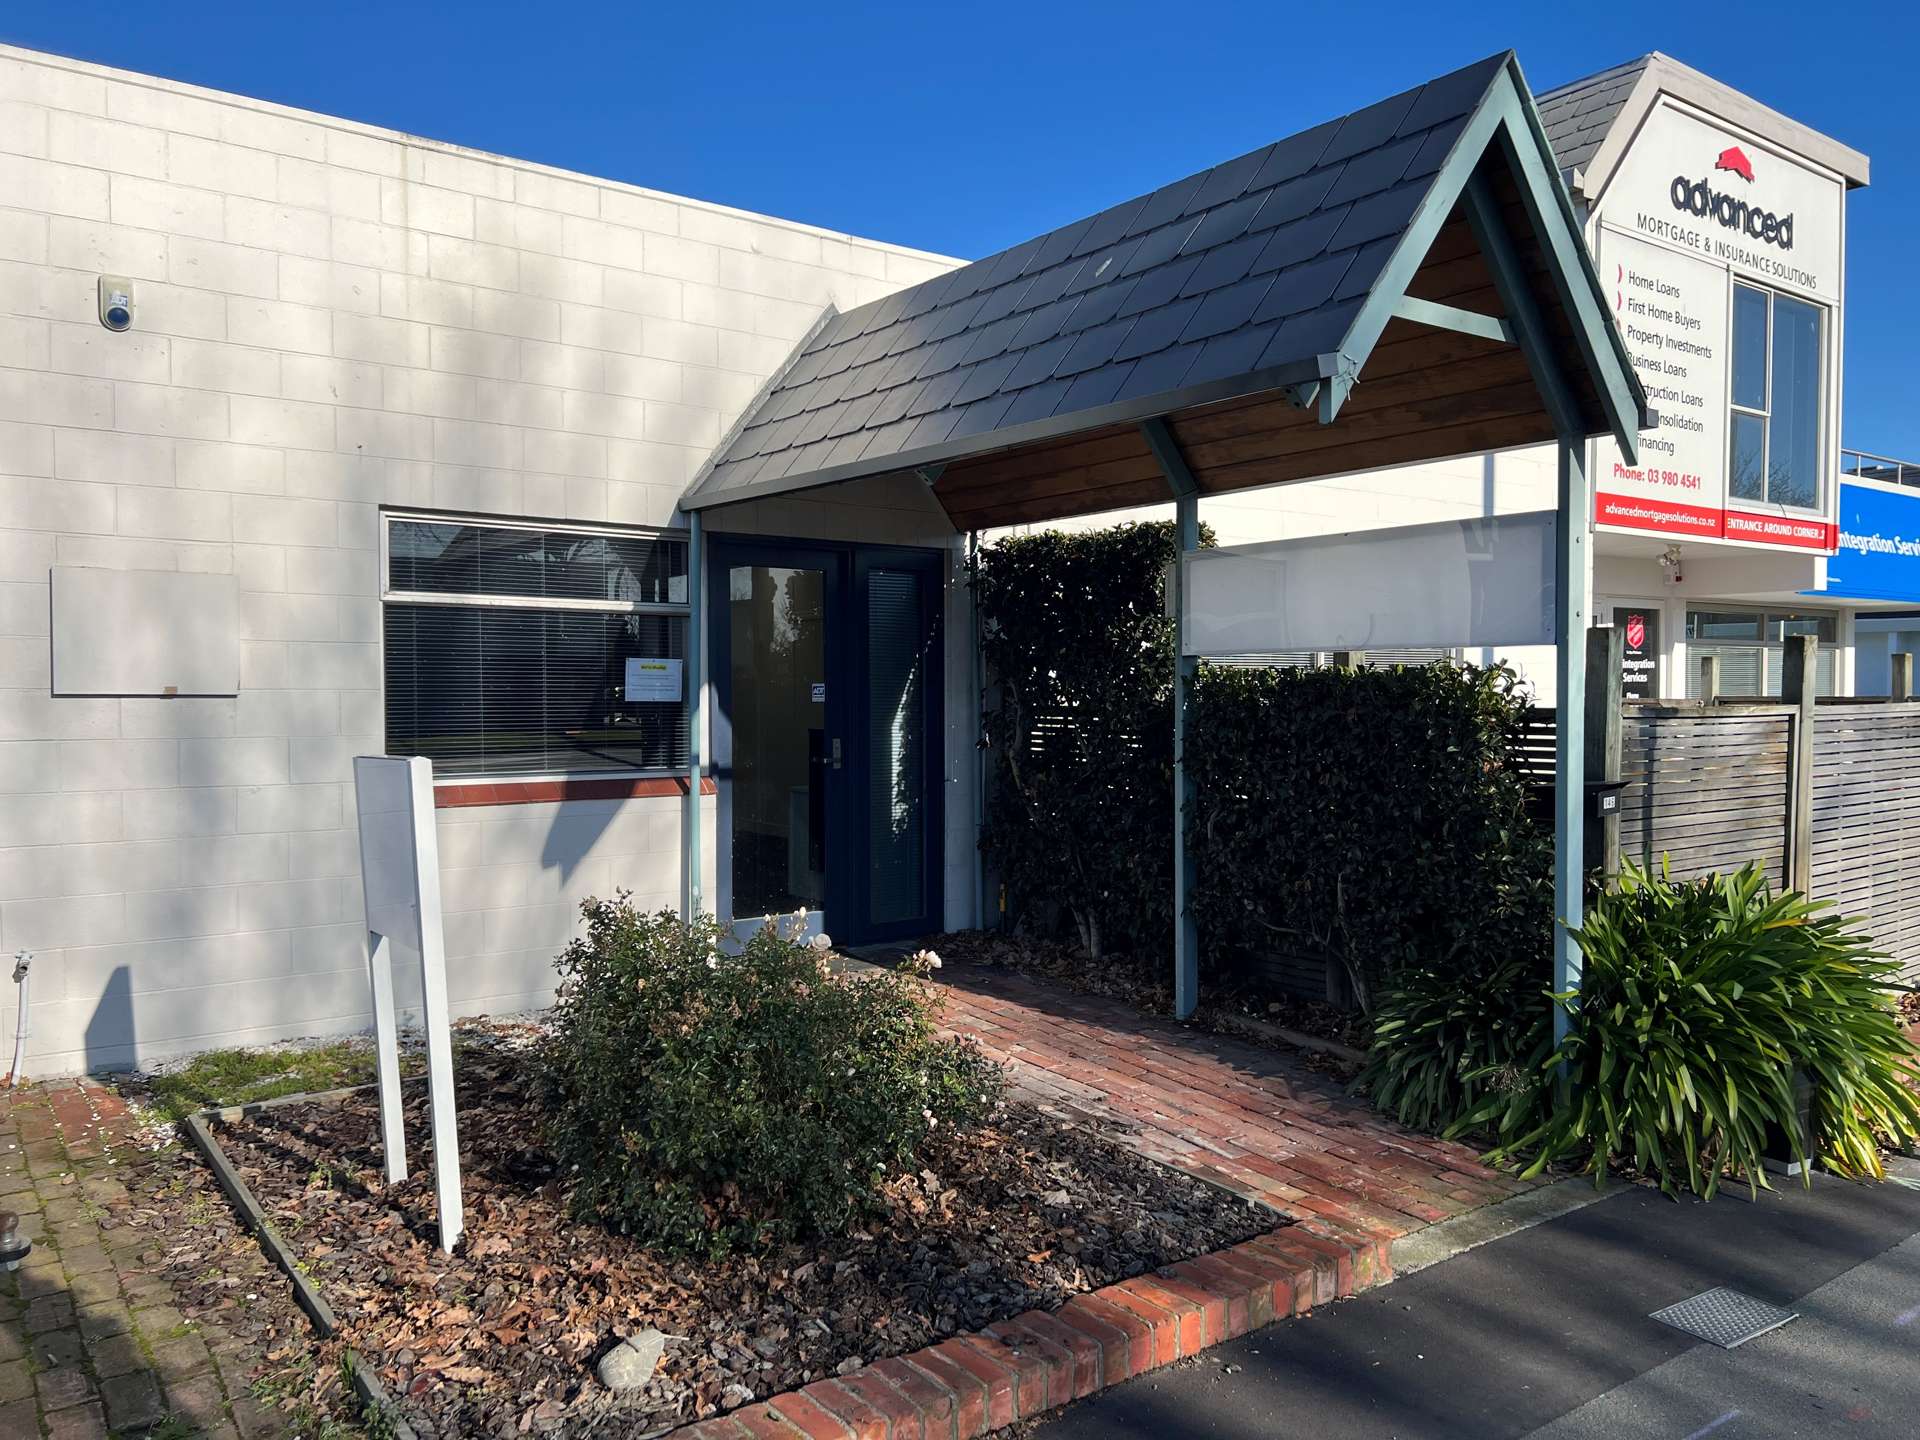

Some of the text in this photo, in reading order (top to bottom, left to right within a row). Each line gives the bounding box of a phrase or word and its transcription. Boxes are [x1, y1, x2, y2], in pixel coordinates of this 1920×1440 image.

[1671, 175, 1793, 250] advanced
[1637, 212, 1817, 289] MORTGAGE & INSURANCE SOLUTIONS
[1628, 270, 1680, 298] Home Loans
[1628, 298, 1701, 330] First Home Buyers
[1627, 325, 1712, 359] Property Investments
[1663, 360, 1687, 378] Loans
[1645, 385, 1703, 408] truction Loans
[1659, 413, 1703, 433] nsolidation
[1613, 463, 1701, 490] Phone: 03 980 4541
[1604, 503, 1716, 527] advancedmortgagesolutions.co.nz
[1727, 517, 1819, 540] ENTRANCE AROUND CORNER
[1838, 531, 1920, 556] ntegration Servi
[1622, 658, 1655, 671] integration
[1622, 672, 1647, 682] Services
